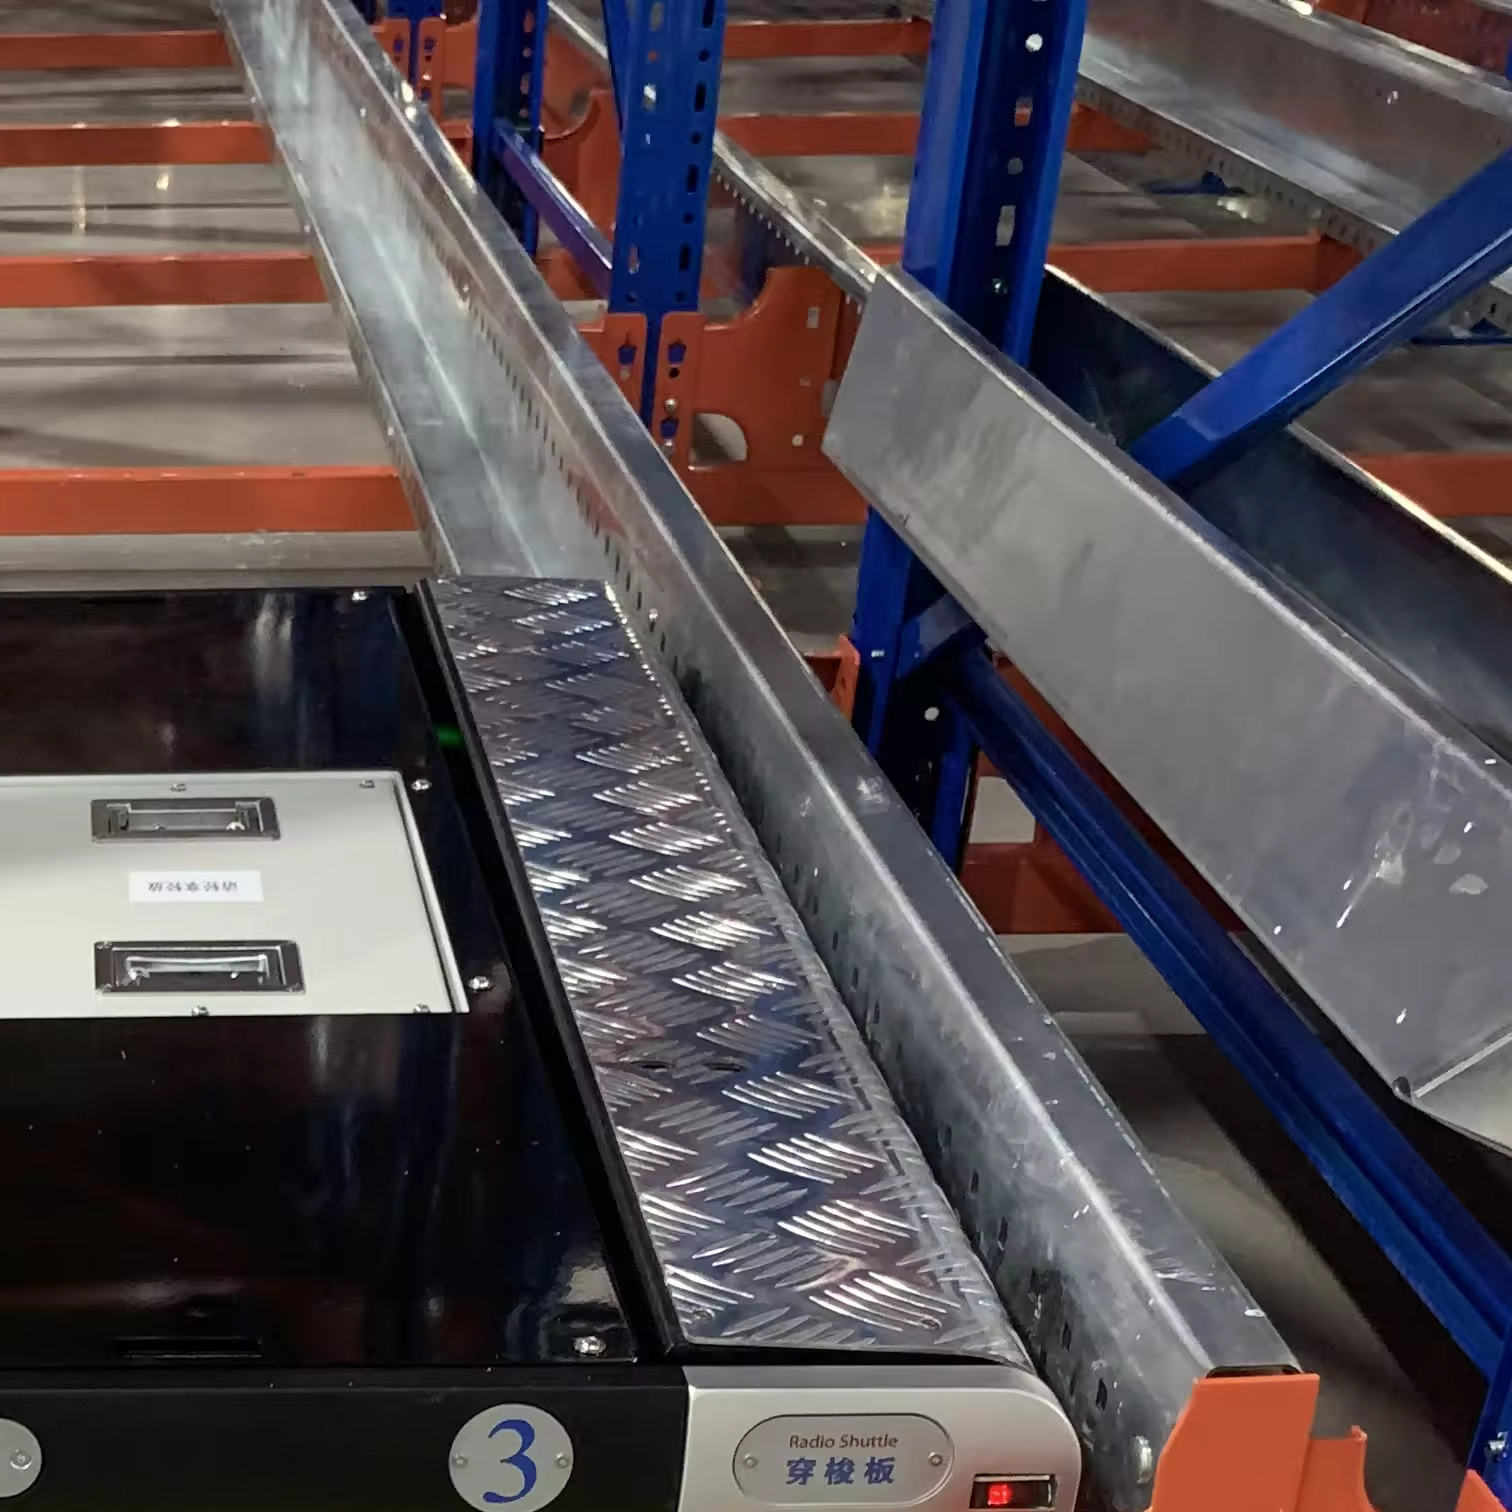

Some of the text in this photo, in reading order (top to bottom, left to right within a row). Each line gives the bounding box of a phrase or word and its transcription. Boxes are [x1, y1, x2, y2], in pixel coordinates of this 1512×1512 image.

[789, 1433, 898, 1448] Radio Shuttle
[482, 1419, 537, 1504] 3
[785, 1456, 896, 1485] 穿梭板
